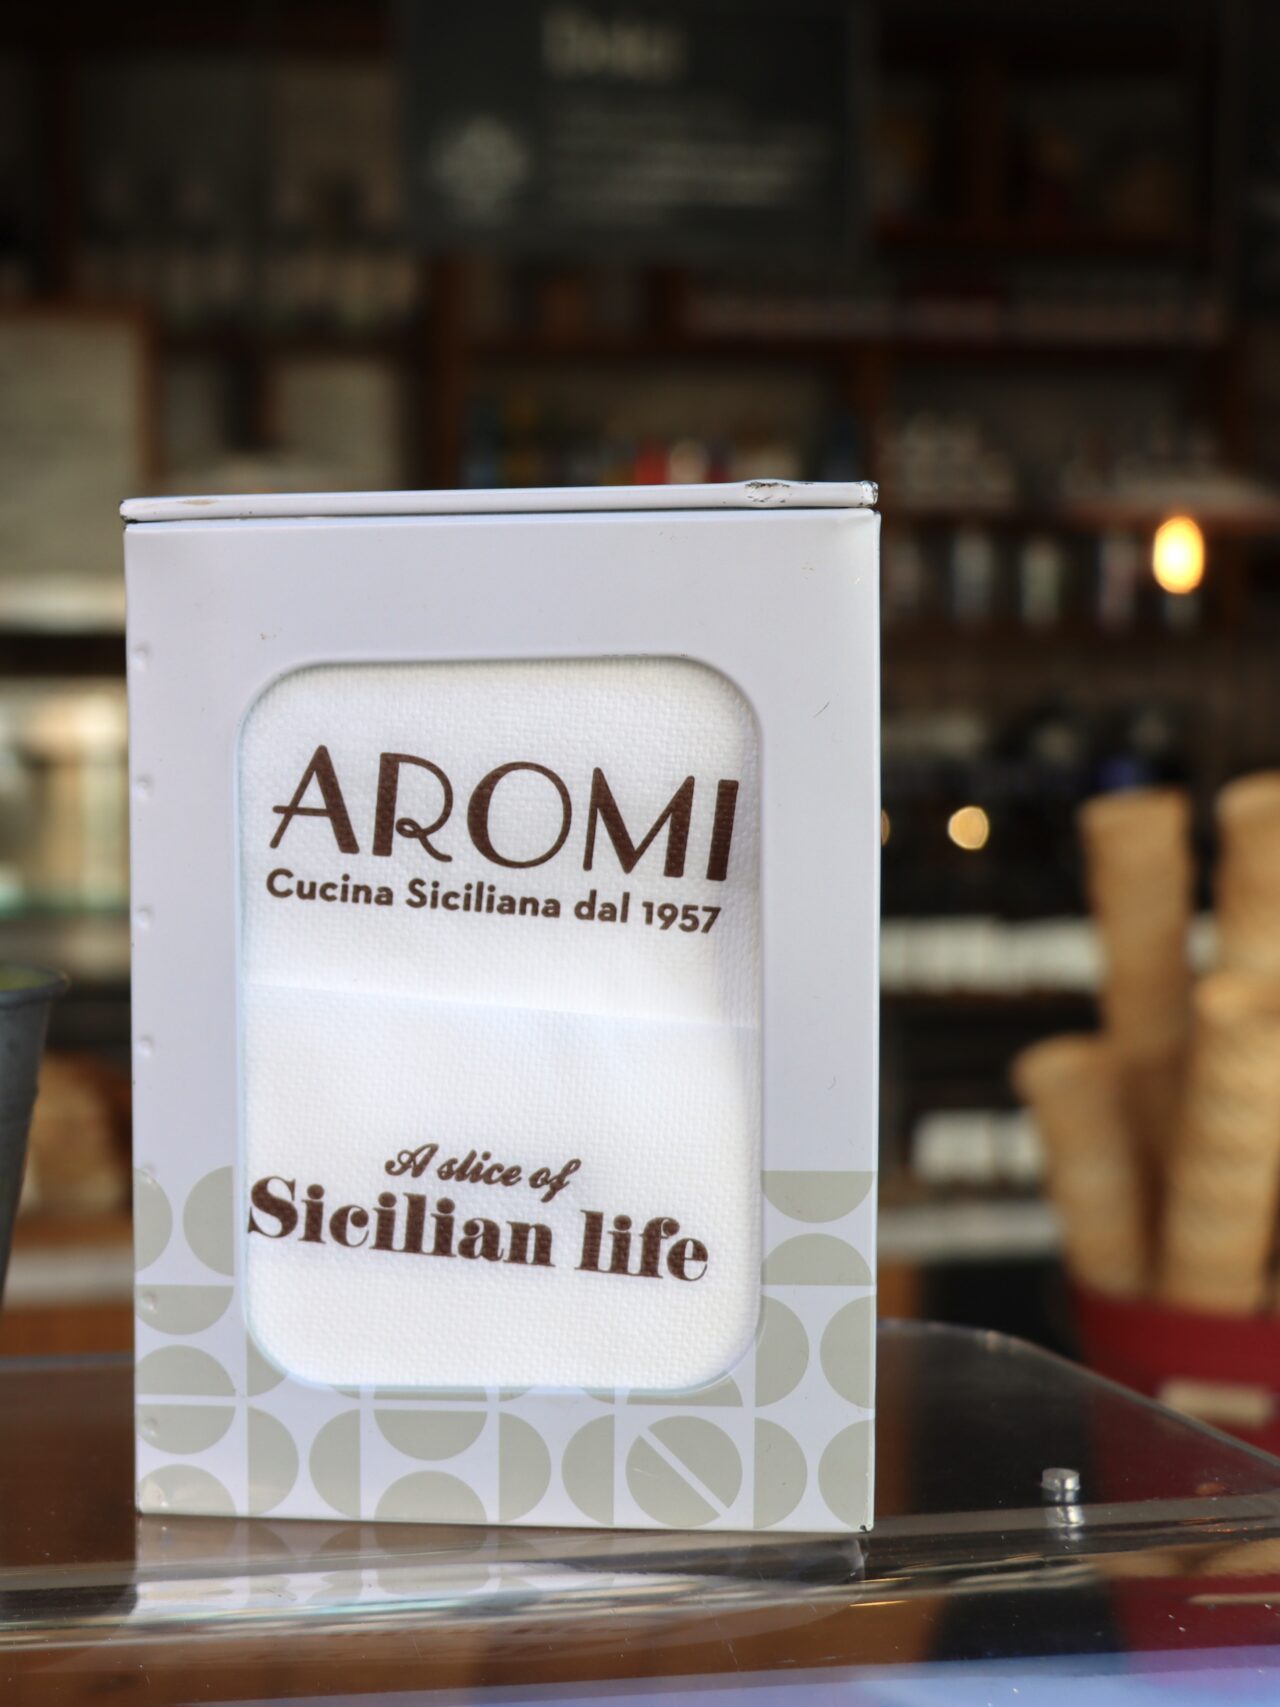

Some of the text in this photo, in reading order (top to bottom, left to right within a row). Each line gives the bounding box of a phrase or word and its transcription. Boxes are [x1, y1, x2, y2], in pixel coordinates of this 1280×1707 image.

[269, 744, 741, 884] AROMI
[266, 867, 723, 935] Cucina Siciliana dal 1957
[384, 1143, 582, 1204] A slice of
[247, 1175, 710, 1282] Sicilian life
